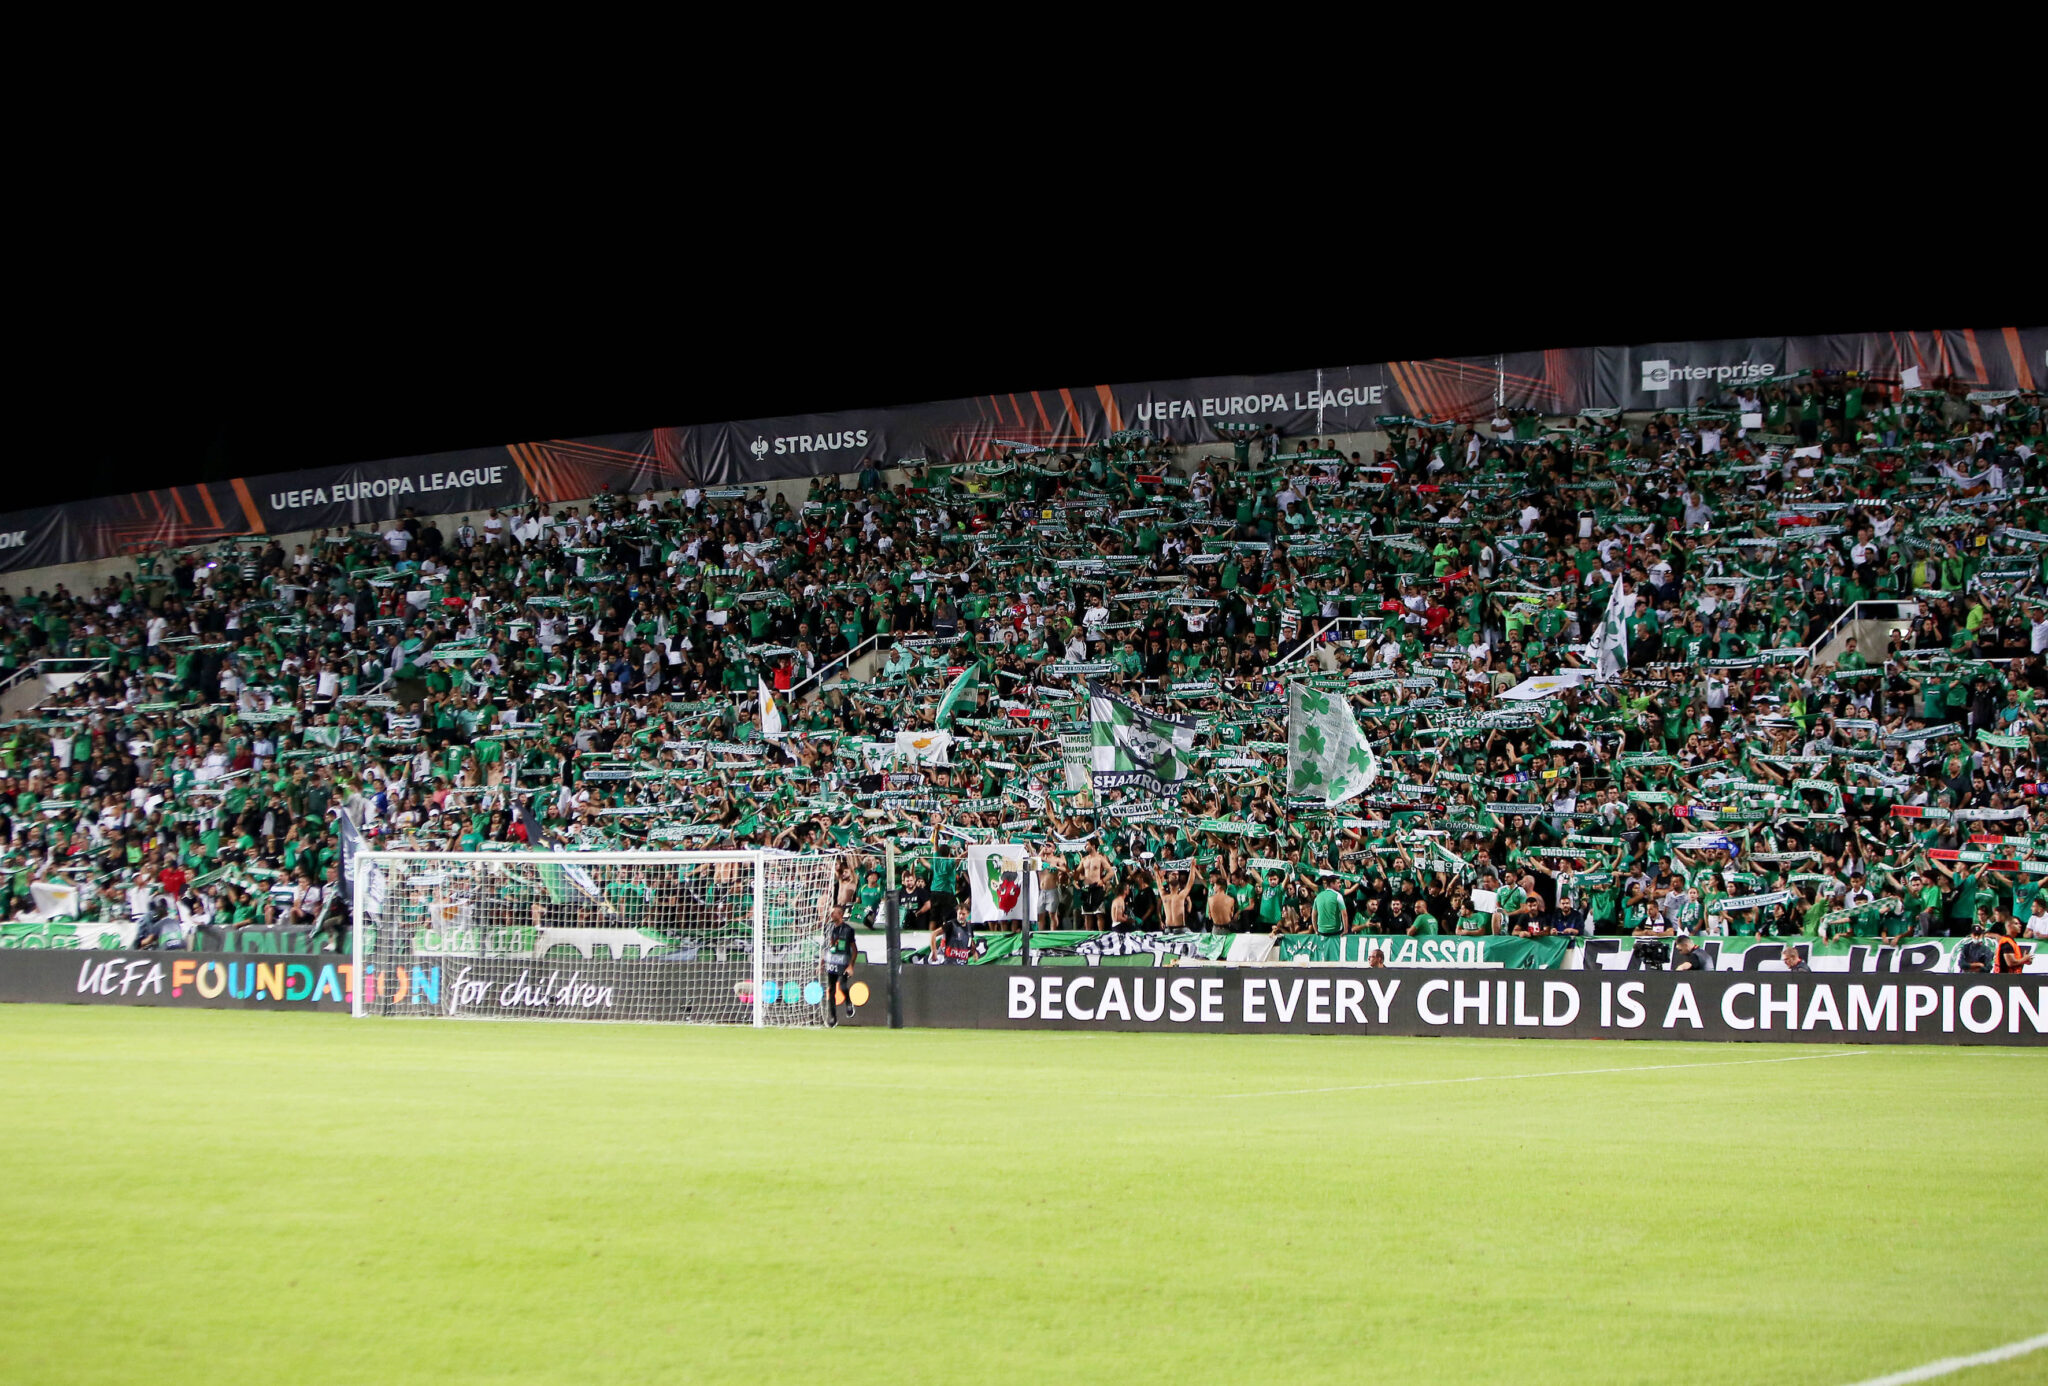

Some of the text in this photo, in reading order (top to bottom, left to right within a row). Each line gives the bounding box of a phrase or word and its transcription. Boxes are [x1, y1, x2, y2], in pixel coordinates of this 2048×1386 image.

[1651, 361, 1776, 383] enterprise
[1137, 385, 1382, 422] UEFA EUROPA LEAGUE
[773, 429, 869, 456] STRAUSS
[269, 466, 503, 511] UEFA EUROPA LEAGUE
[1093, 774, 1182, 797] SHAMROCKS
[1733, 781, 1776, 793] OMONOIA
[1216, 822, 1255, 832] OMONOIA
[1541, 848, 1585, 858] OMONOIA
[77, 958, 613, 1014] UEFA FOUNDATION for children
[1008, 975, 2048, 1034] BECAUSE EVERY CHILD IS A CHAMPION
